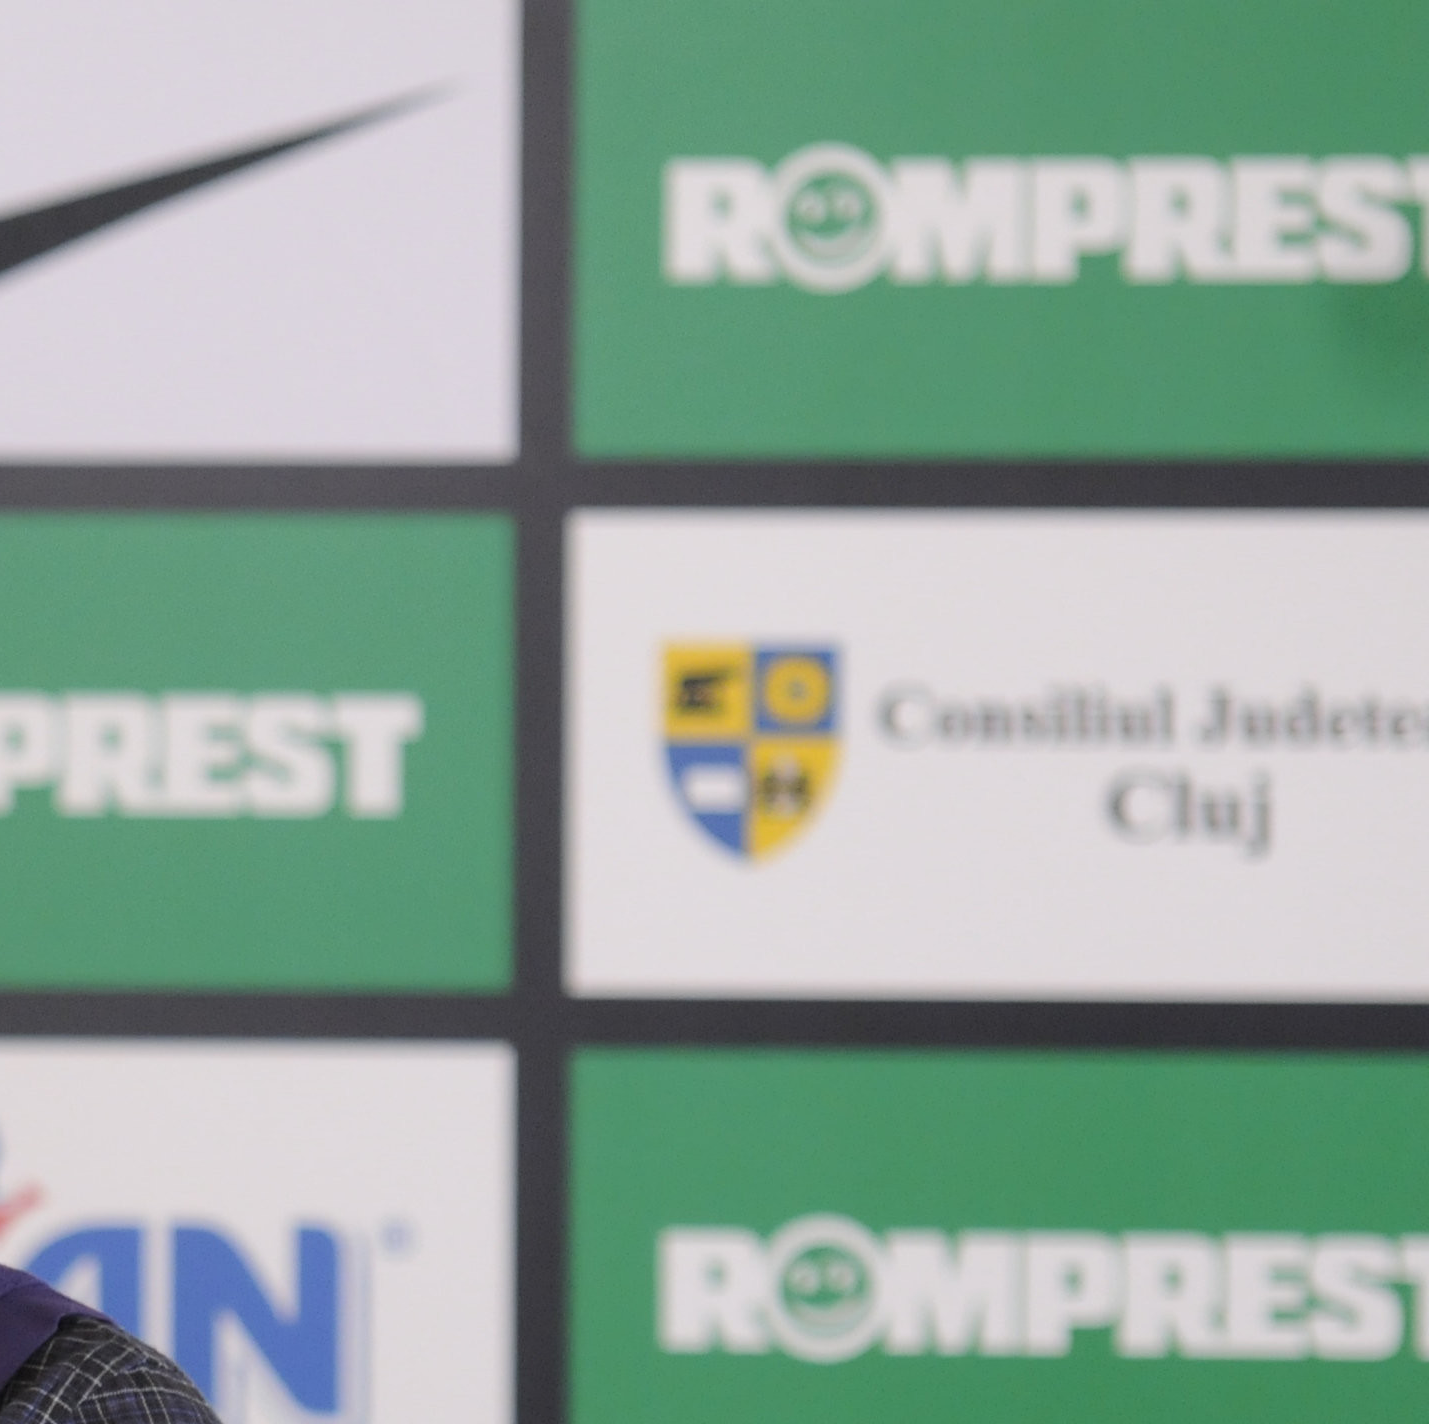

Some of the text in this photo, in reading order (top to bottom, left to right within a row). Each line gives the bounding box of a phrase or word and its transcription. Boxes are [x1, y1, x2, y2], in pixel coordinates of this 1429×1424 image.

[662, 141, 1429, 294] ROMPRES
[876, 681, 1175, 751] Consiliul
[1104, 763, 1272, 861] Cluj
